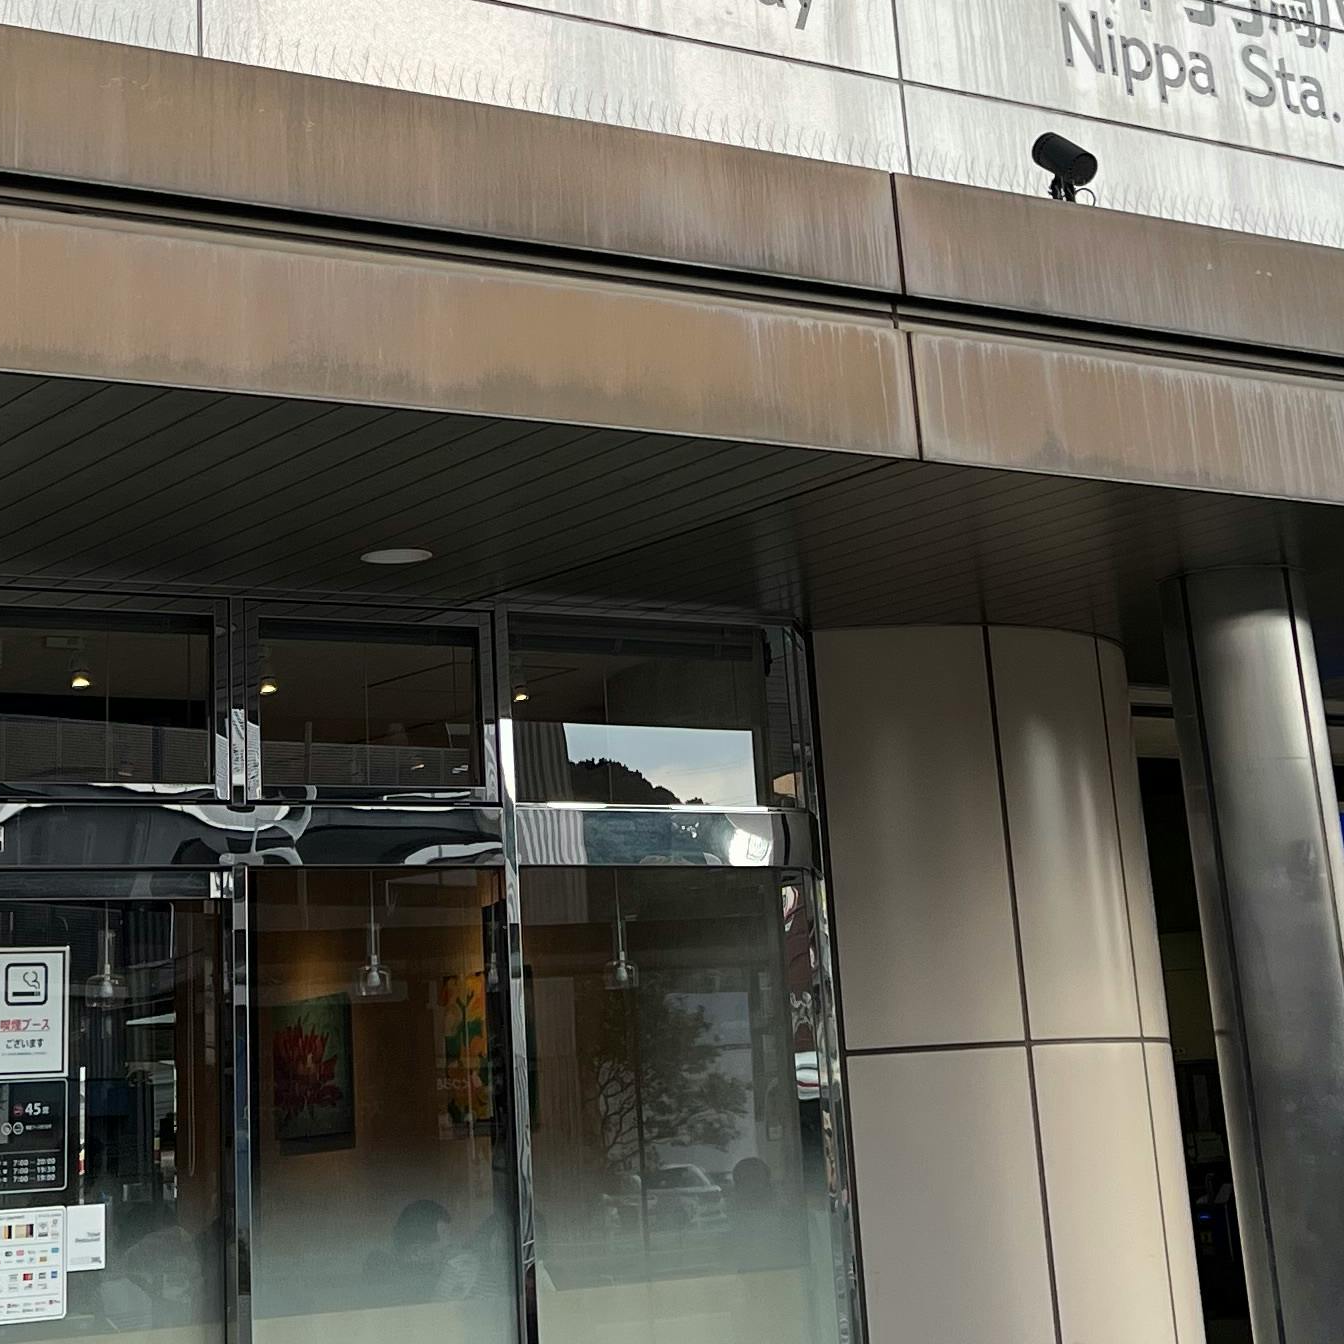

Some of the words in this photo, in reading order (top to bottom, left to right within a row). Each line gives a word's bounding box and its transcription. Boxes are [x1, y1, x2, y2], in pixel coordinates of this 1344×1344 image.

[1058, 1, 1218, 104] Nippa
[1241, 44, 1342, 123] Sta.
[6, 1038, 44, 1049] ございます
